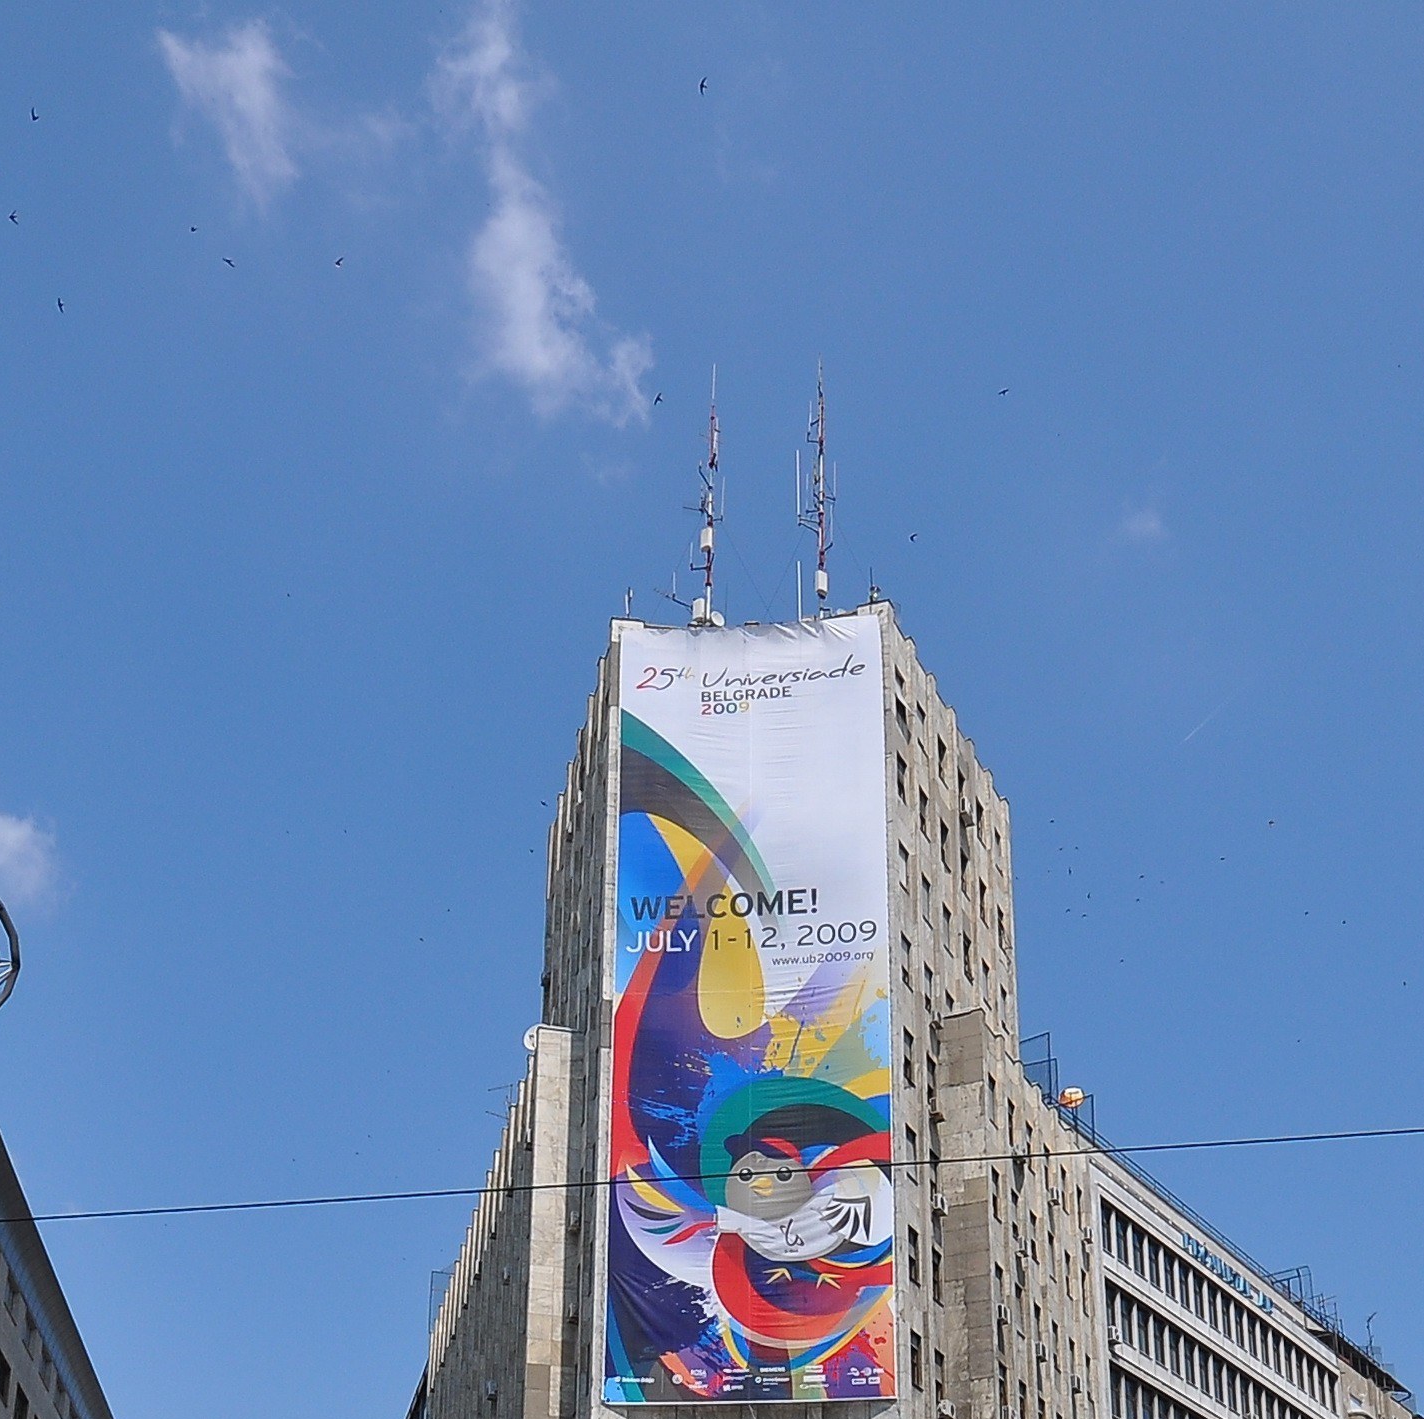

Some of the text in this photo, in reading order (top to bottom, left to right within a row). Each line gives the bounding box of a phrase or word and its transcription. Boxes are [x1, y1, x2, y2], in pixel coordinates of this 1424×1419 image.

[700, 653, 867, 689] Universiade
[701, 685, 793, 703] BELGRADE
[701, 700, 750, 716] 2009
[630, 887, 819, 922] WELCOME!
[625, 928, 699, 954] JULY
[797, 919, 878, 947] 2009
[770, 950, 875, 968] www.ub2009.org
